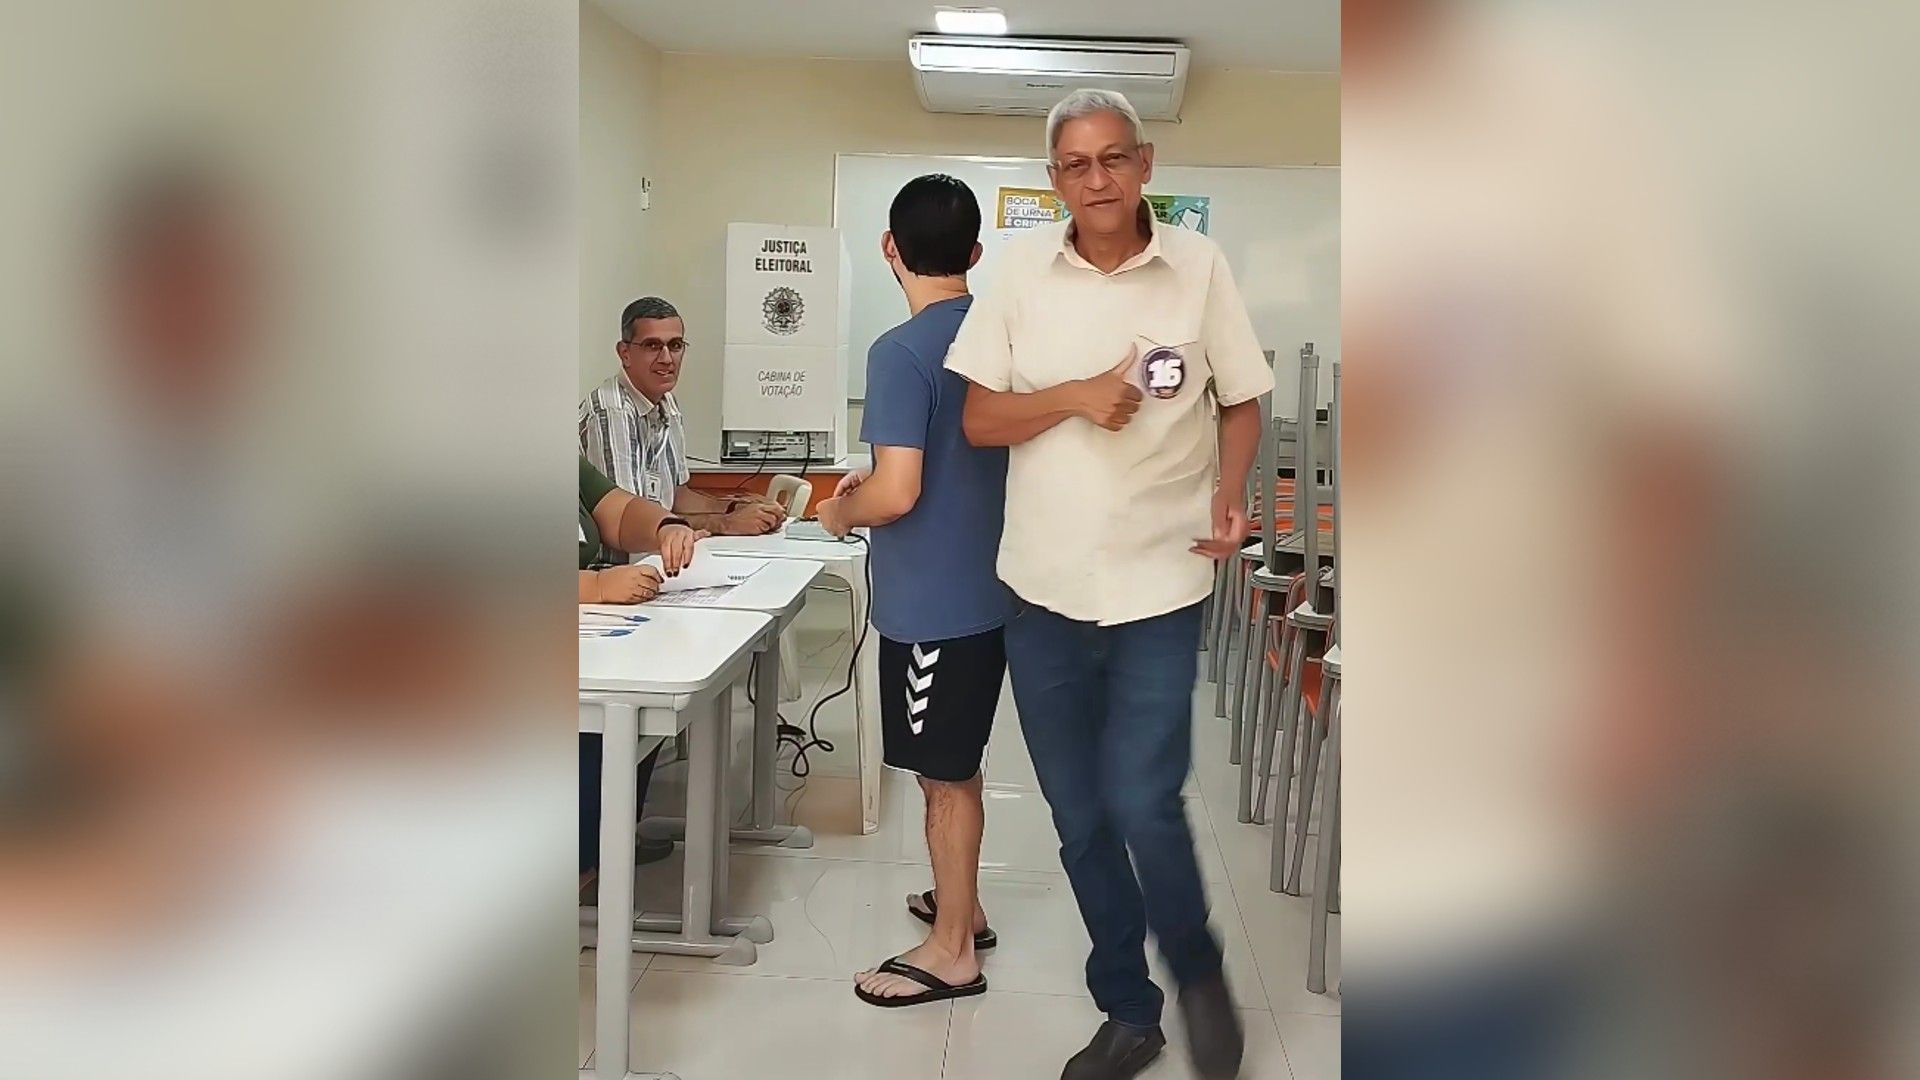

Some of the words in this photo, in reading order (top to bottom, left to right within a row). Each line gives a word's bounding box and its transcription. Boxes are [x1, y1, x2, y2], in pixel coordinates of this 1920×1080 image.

[1006, 196, 1037, 206] BOCA
[1006, 207, 1020, 216] DE
[1022, 208, 1052, 217] URNA
[761, 239, 807, 257] JUSTIÇA
[755, 257, 813, 273] ELEITORAL
[758, 370, 791, 382] CABINA
[793, 370, 806, 382] DE
[1147, 358, 1182, 388] 16
[761, 383, 802, 398] VOTAÇÃO
